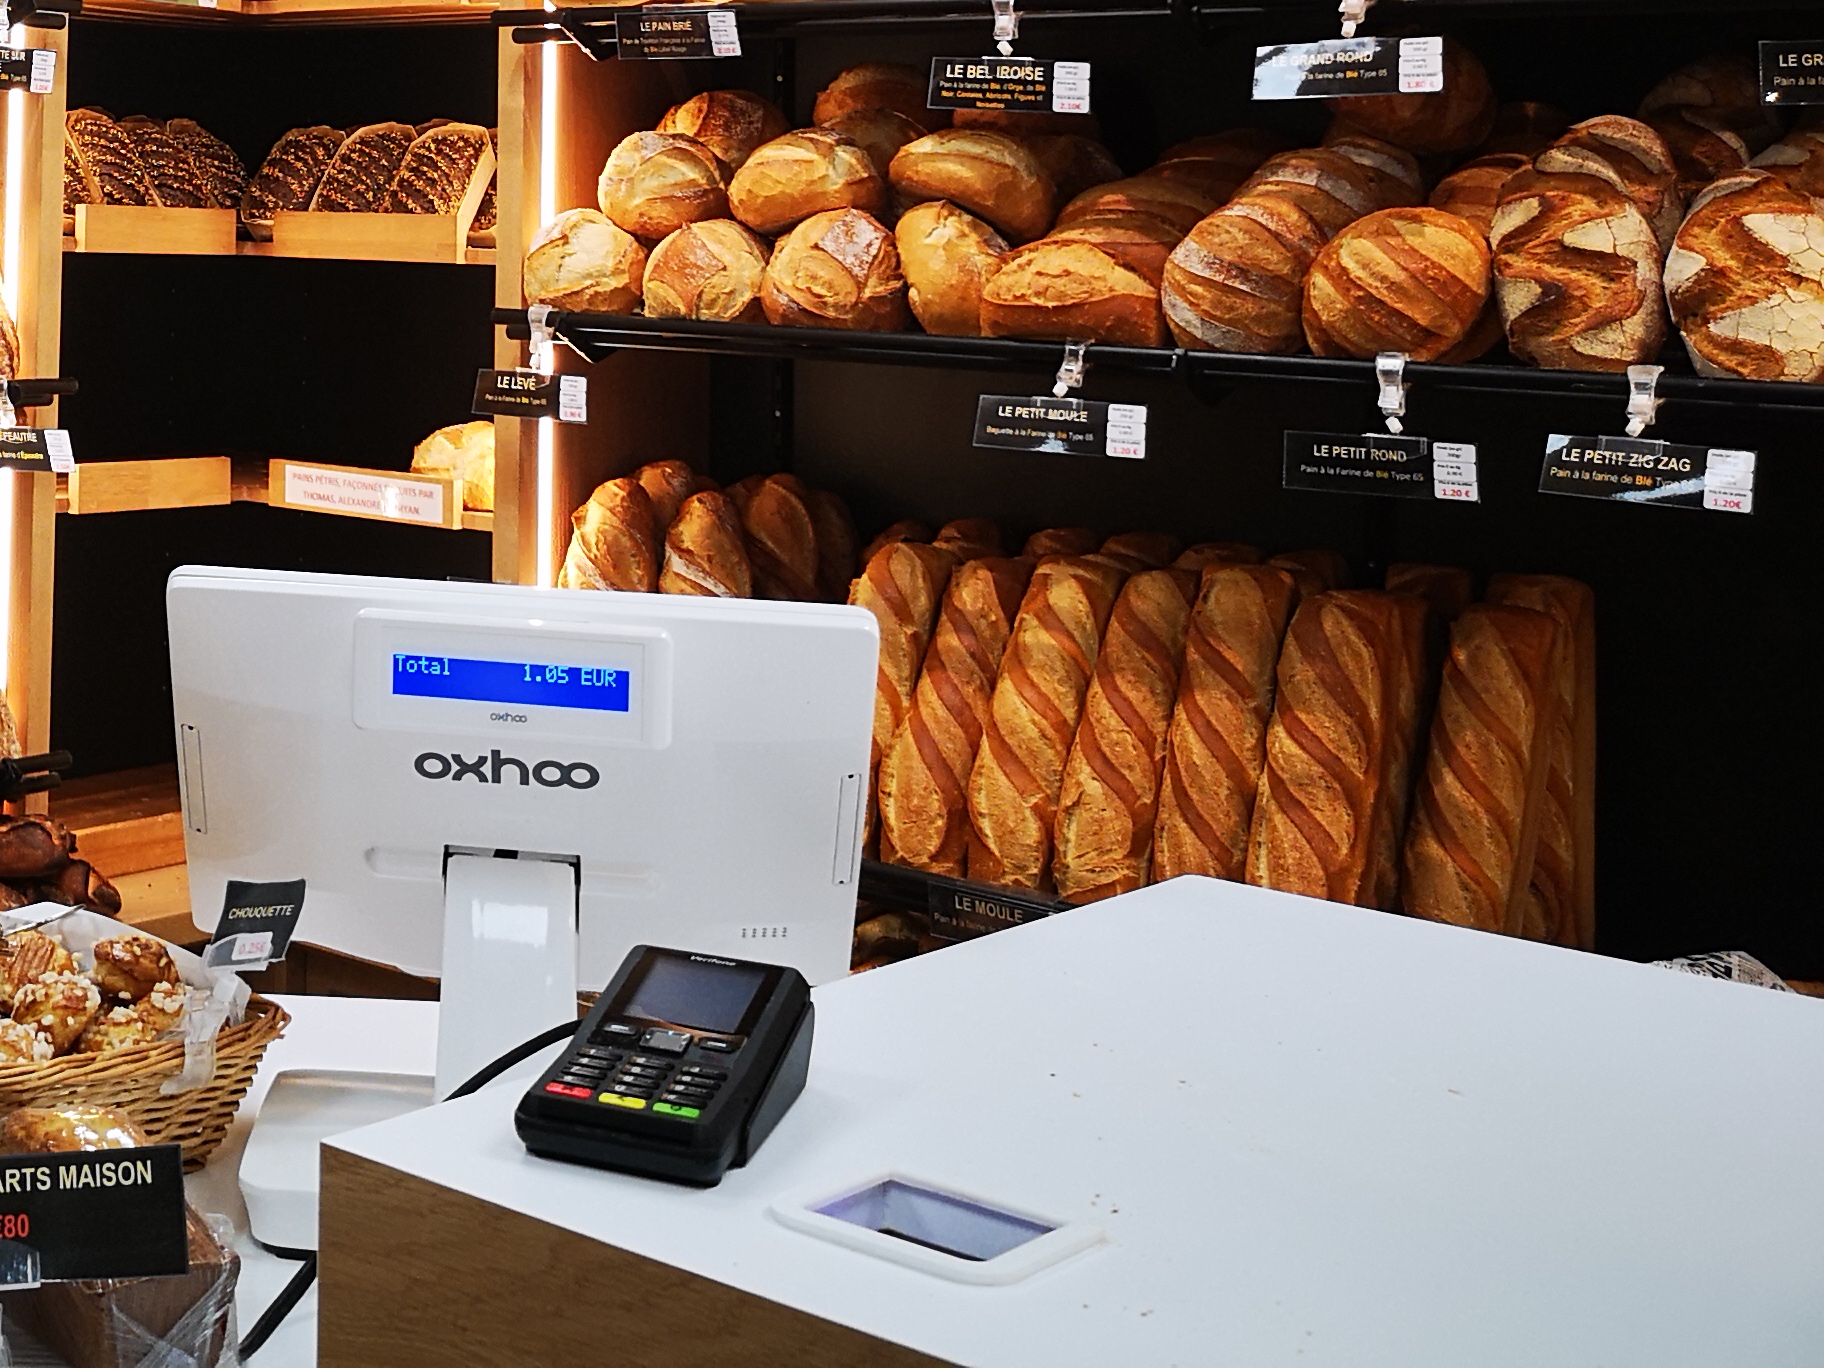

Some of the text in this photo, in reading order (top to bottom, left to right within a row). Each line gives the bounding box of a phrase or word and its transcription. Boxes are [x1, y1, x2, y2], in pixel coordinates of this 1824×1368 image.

[640, 22, 651, 31] LE
[652, 22, 671, 30] PAIN
[1290, 54, 1332, 66] GRAND
[1336, 50, 1374, 63] ROND
[1779, 54, 1797, 67] LE
[946, 64, 1044, 81] LE BEL IROISE
[497, 375, 536, 390] LE LEVÉ
[998, 406, 1088, 422] LE PETIT MOULE
[1313, 444, 1407, 462] LE PETIT ROND
[1561, 448, 1691, 472] LE PETIT ZIG ZAG
[1300, 464, 1318, 473] Pain
[1320, 465, 1326, 474] à
[1327, 466, 1334, 474] la
[1336, 467, 1361, 476] Farine
[1363, 469, 1374, 477] de
[1391, 471, 1411, 481] Type
[1550, 467, 1653, 486] Pain à la farine de Blé
[1442, 488, 1470, 498] 1.20 €
[1713, 498, 1742, 509] 1.20€
[395, 655, 617, 687] Total 1.05 EUR
[490, 712, 527, 723] oxhoo
[414, 749, 600, 789] oxhoo
[228, 905, 295, 920] CHOUQUETTE
[955, 895, 1024, 923] LE MOULE
[58, 1159, 153, 1190] MAISON
